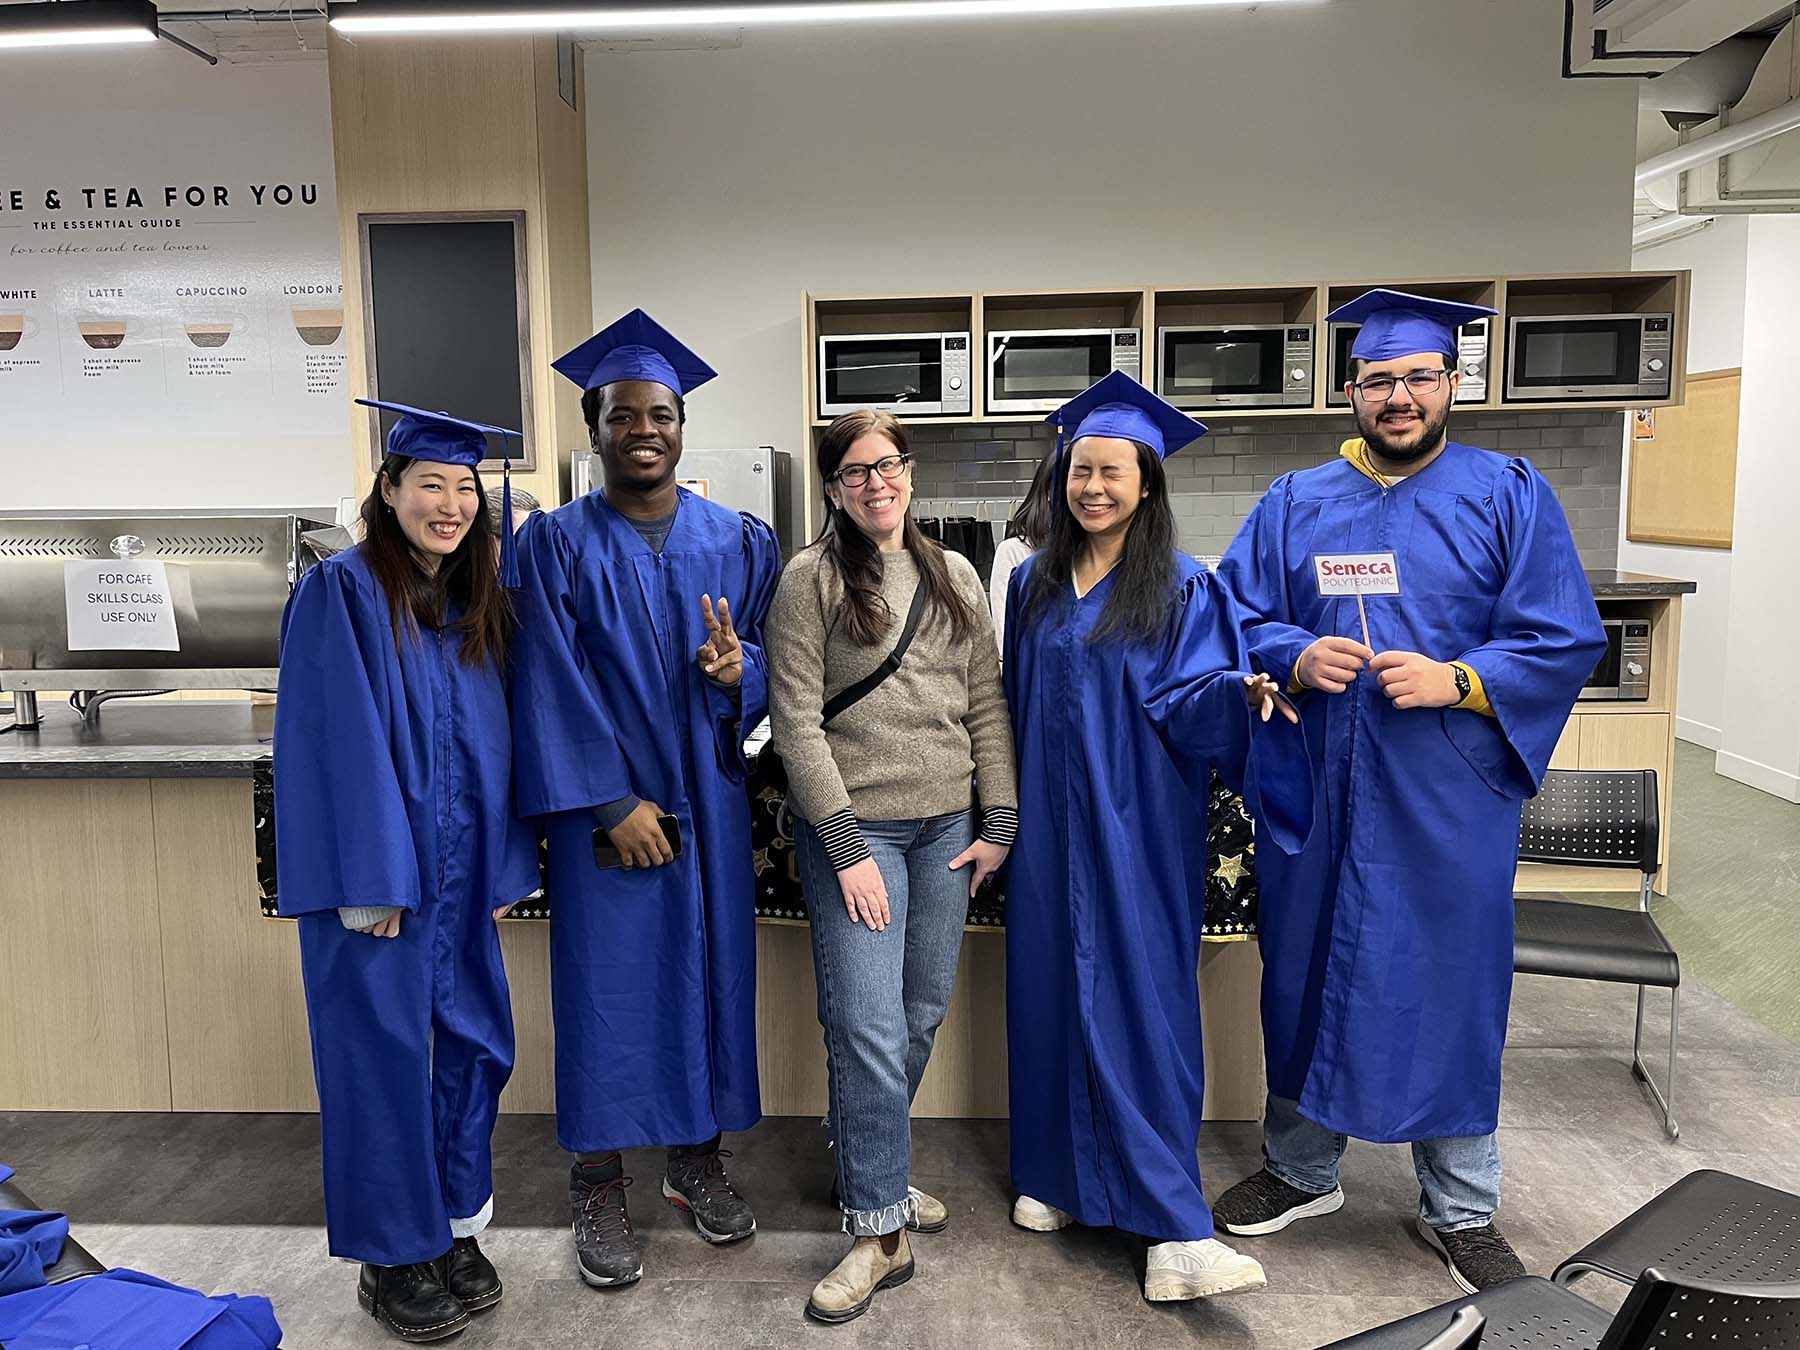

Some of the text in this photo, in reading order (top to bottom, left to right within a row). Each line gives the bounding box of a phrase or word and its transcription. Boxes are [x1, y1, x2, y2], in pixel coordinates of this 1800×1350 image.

[0, 184, 317, 210] E & TEA FOR YOU
[33, 219, 181, 230] THE ESSENTIAL GUIDE
[10, 241, 209, 256] for coffee and tea lovers
[0, 290, 37, 299] WHITE
[89, 288, 124, 298] LATTE
[176, 286, 248, 296] CAPUCCINO
[283, 285, 333, 295] LONDON
[1321, 560, 1392, 576] Seneca
[98, 574, 153, 585] FOR CAFE
[1323, 577, 1395, 587] POLYTECHNIC
[87, 593, 164, 604] SKILLS CLASS
[101, 612, 157, 622] USE ONLY
